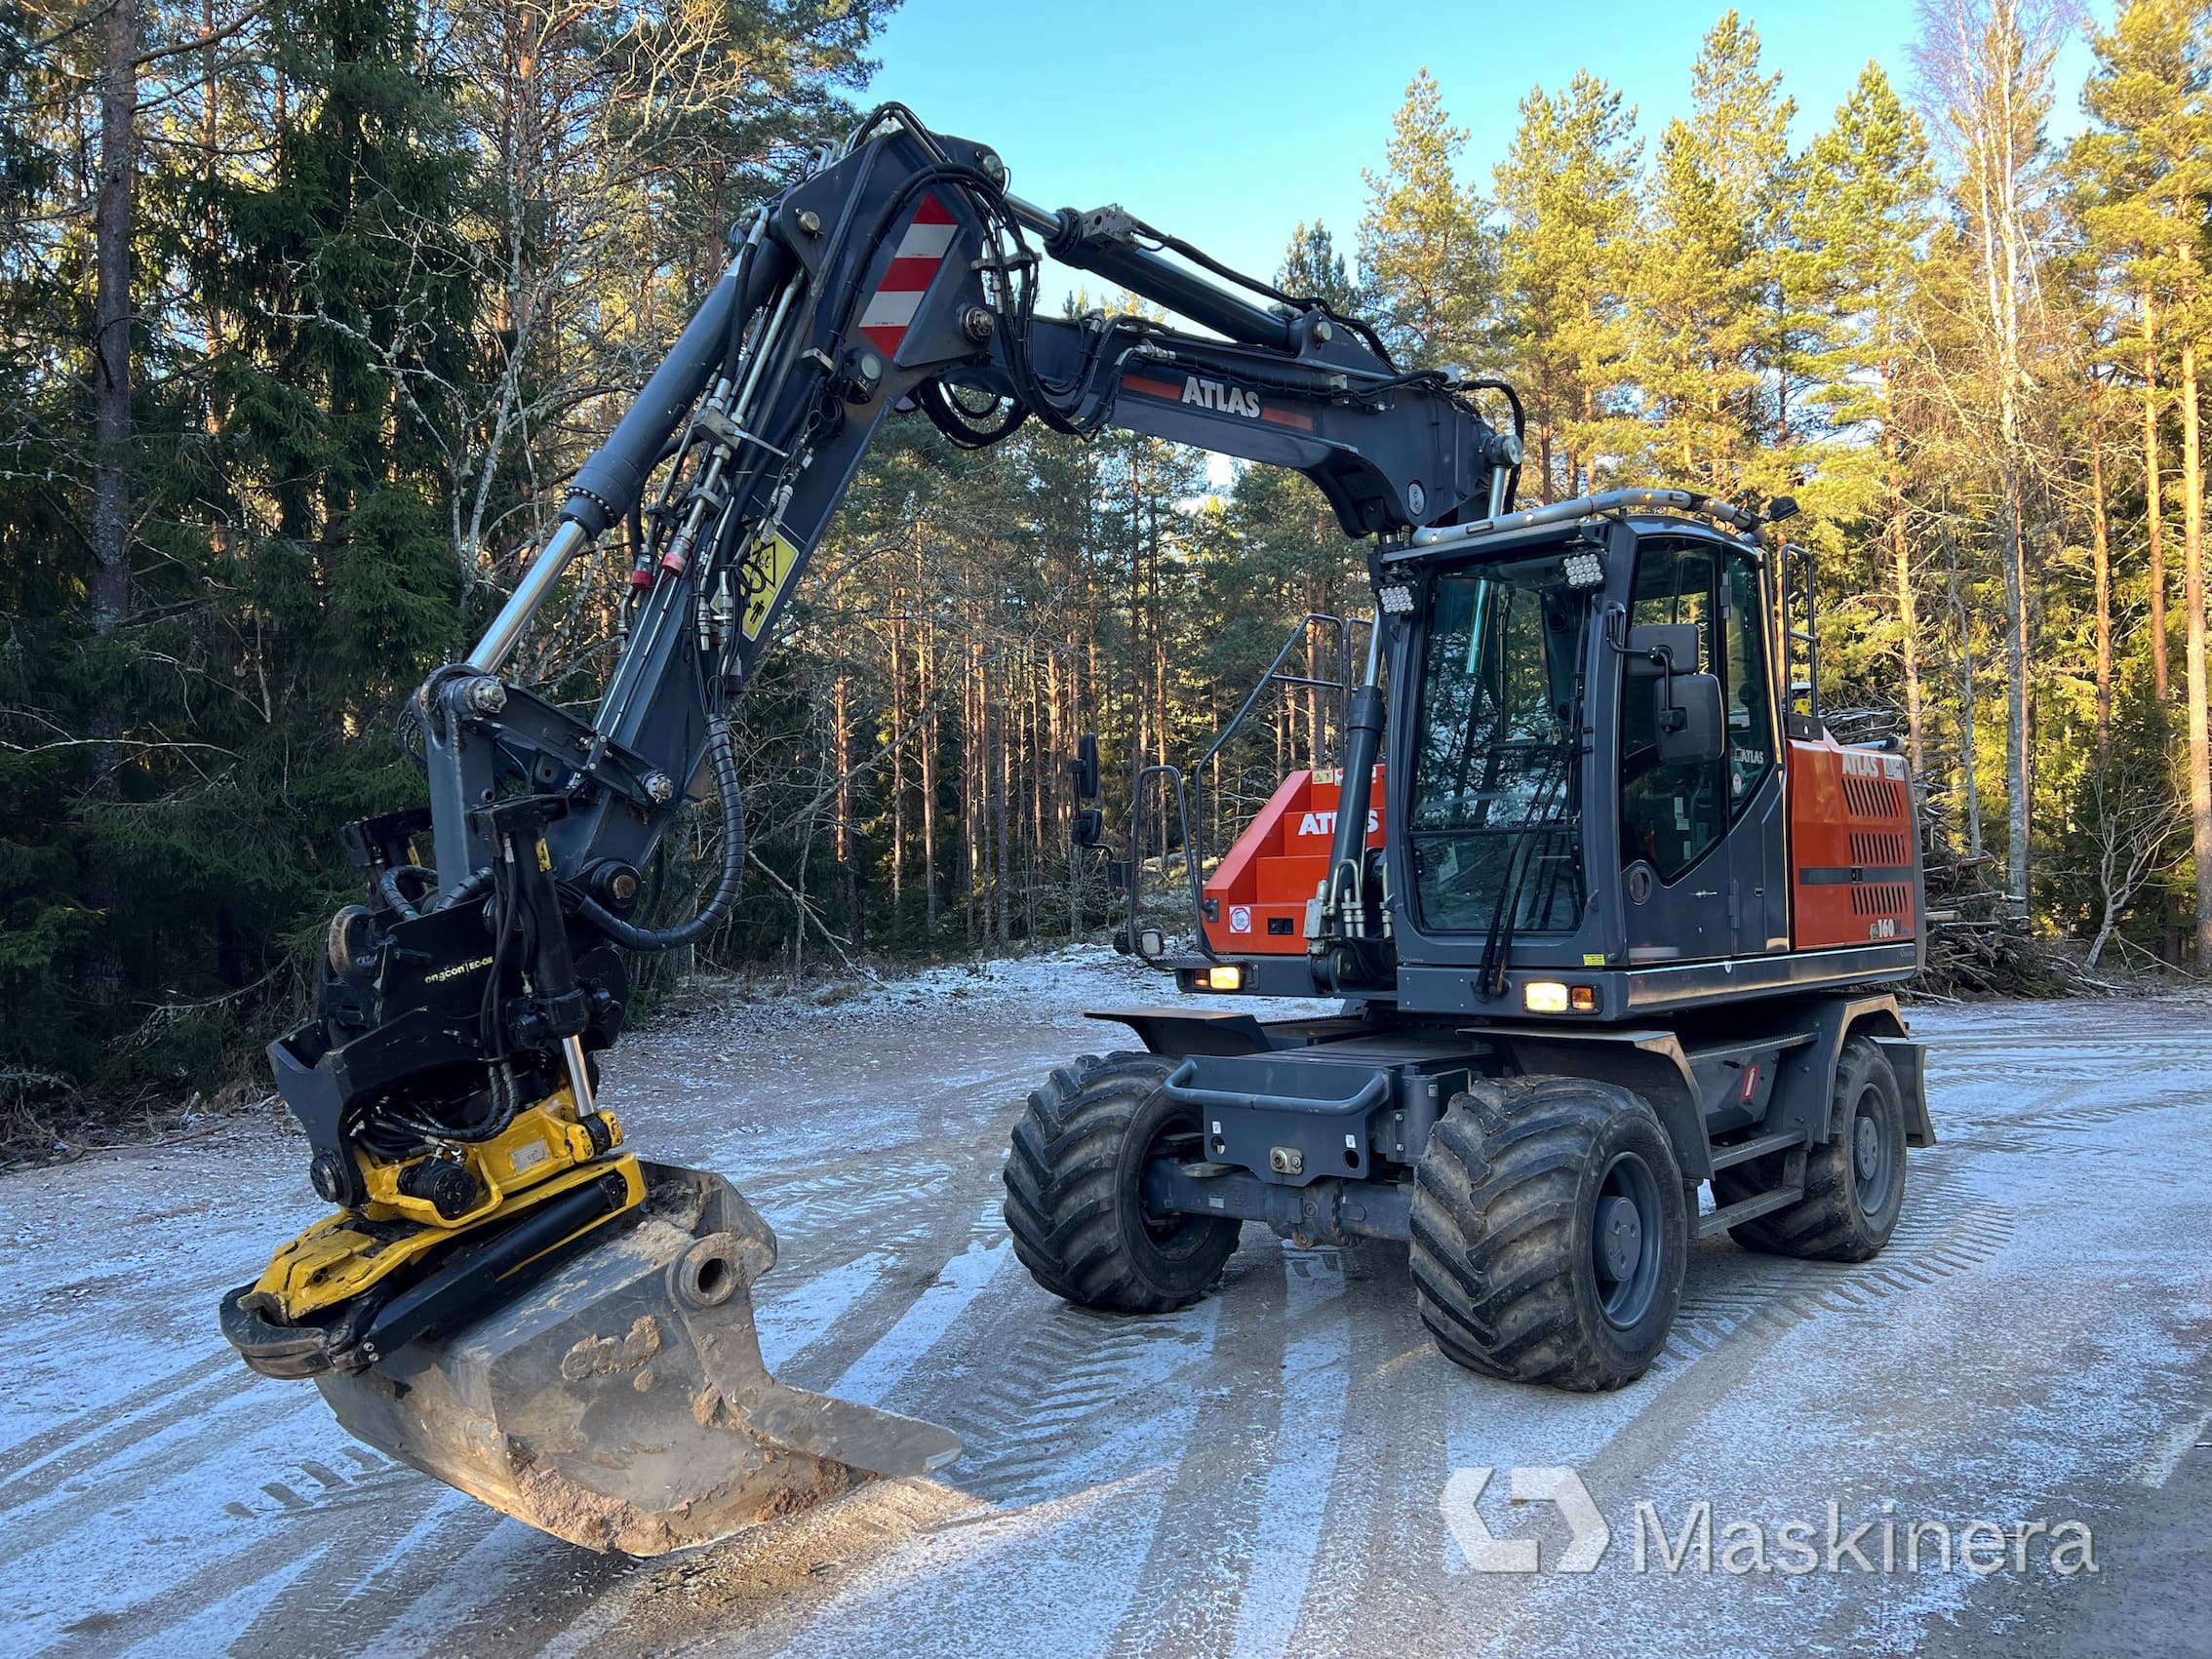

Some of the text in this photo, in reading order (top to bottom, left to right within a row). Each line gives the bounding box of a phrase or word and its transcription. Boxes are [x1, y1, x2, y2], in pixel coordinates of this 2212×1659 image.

[1182, 375, 1261, 418] ATLAS
[1741, 748, 1764, 765] ATLAS
[1842, 753, 1879, 778] ATLAS
[1298, 810, 1379, 836] ATS
